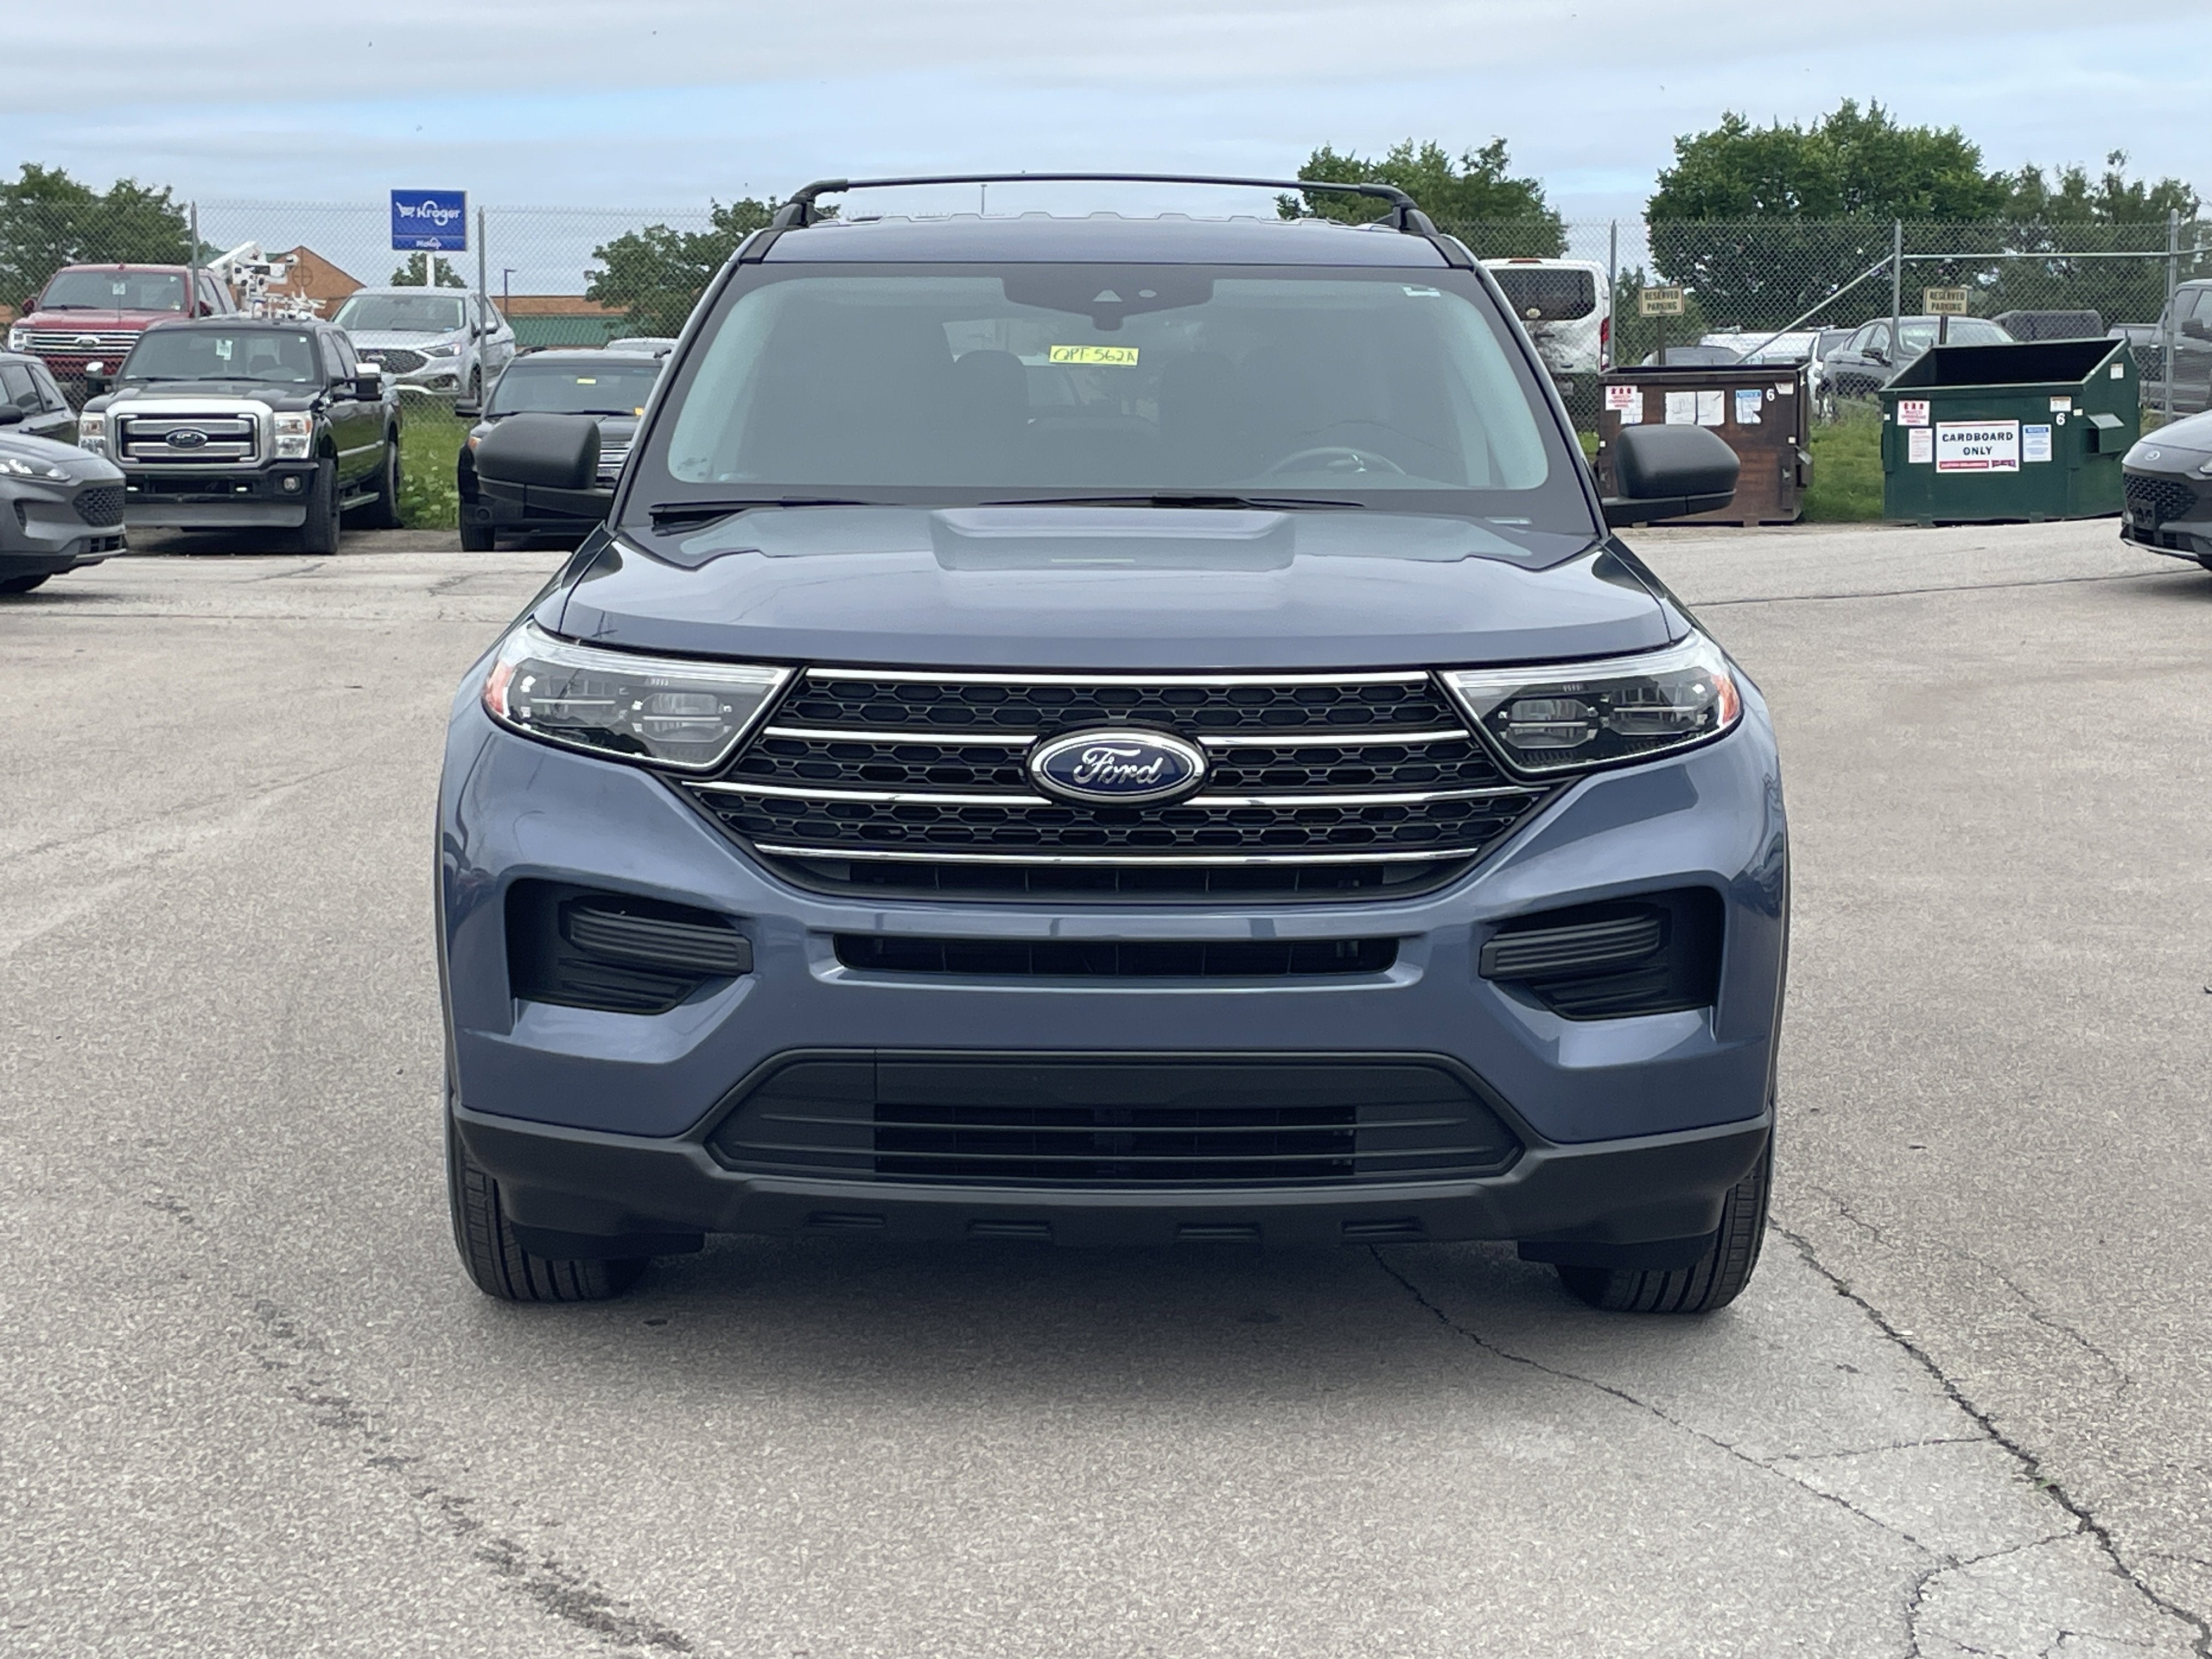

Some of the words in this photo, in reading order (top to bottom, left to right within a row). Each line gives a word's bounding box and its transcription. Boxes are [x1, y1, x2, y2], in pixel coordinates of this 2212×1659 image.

[416, 200, 460, 225] Kroger
[1767, 388, 1775, 402] 6
[2056, 413, 2065, 425] 6
[1942, 432, 2013, 442] CARDBOARD
[1963, 446, 1992, 455] ONLY
[1073, 747, 1164, 784] Ford
